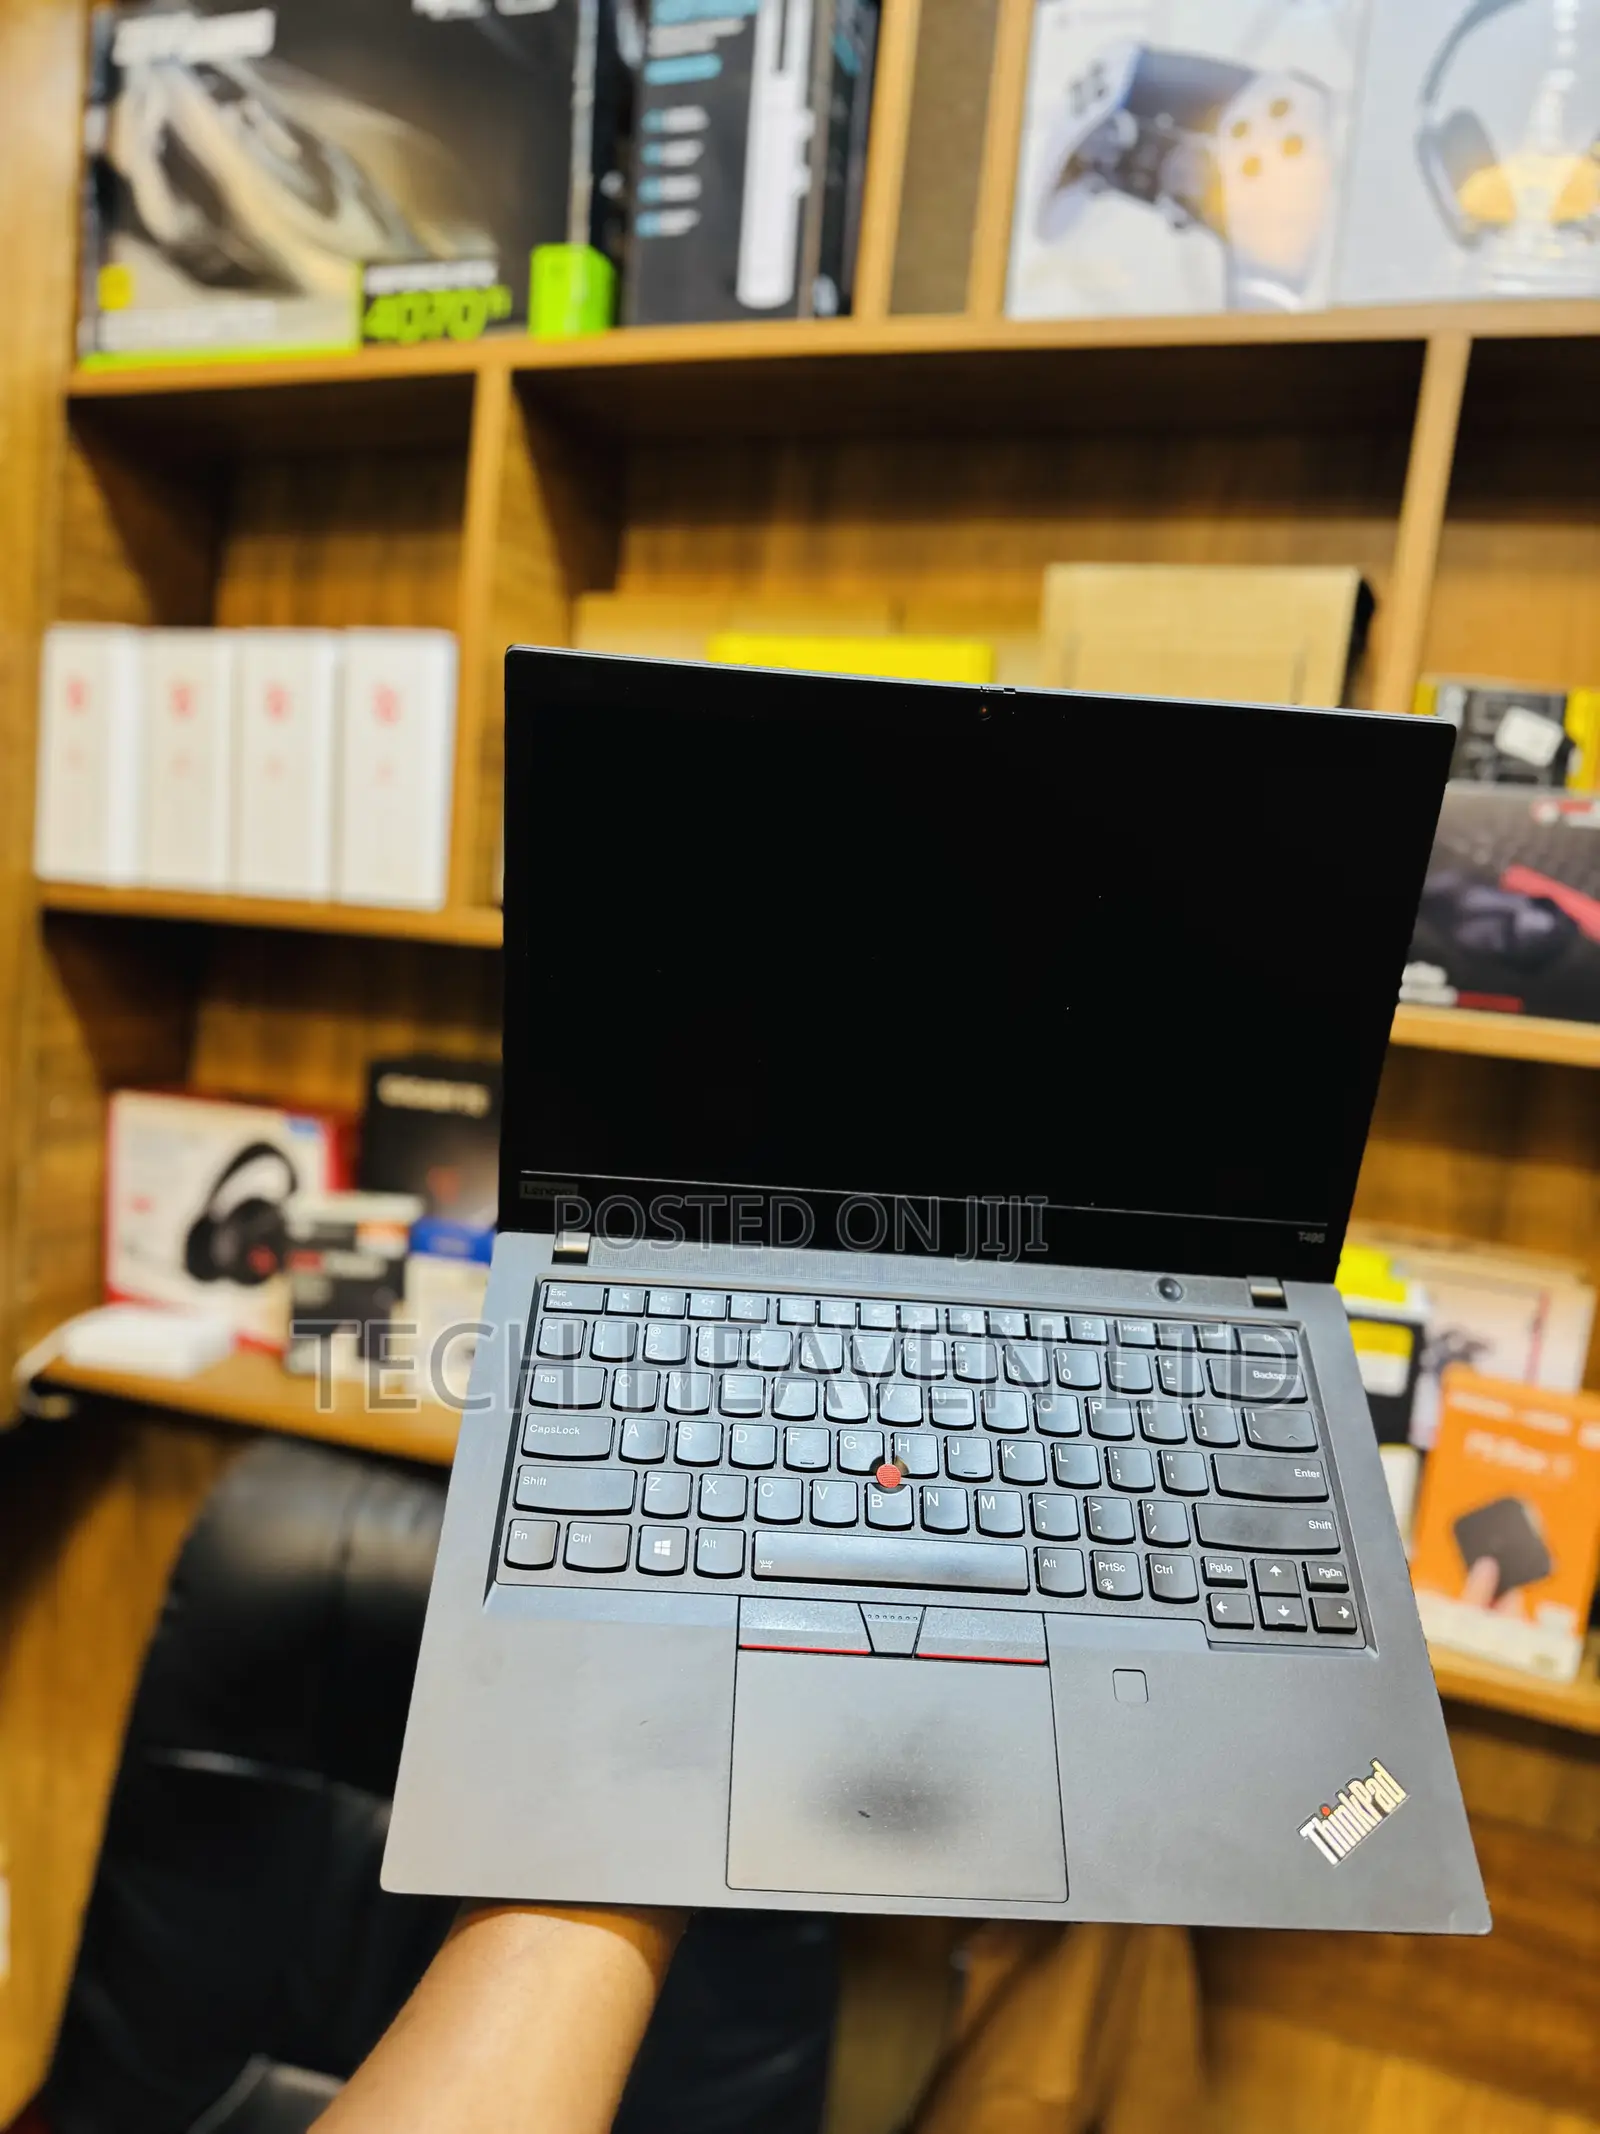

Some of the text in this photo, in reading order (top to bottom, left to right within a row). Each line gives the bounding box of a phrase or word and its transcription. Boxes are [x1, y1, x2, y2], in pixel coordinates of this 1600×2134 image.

[550, 1288, 567, 1297] Esc
[1122, 1324, 1148, 1333] Home
[649, 1343, 659, 1355] 2
[701, 1346, 710, 1358] 3
[753, 1348, 763, 1360] 4
[805, 1351, 815, 1364] 5
[908, 1357, 918, 1370] 7
[1011, 1364, 1021, 1377] 9
[540, 1374, 557, 1383] Tab
[618, 1373, 632, 1388] Q
[673, 1377, 691, 1391] W
[725, 1381, 737, 1394] E
[884, 1388, 895, 1401] Y
[935, 1391, 947, 1406] U
[1091, 1401, 1103, 1415] P
[529, 1423, 581, 1436] CapsLock
[626, 1424, 640, 1438] A
[680, 1426, 693, 1441] S
[735, 1429, 748, 1443] D
[789, 1432, 800, 1446] F
[843, 1435, 857, 1450] G
[897, 1438, 910, 1453] H
[951, 1442, 961, 1456] J
[1003, 1444, 1017, 1460] K
[1057, 1448, 1069, 1463] L
[1293, 1468, 1320, 1479] Enter
[522, 1475, 548, 1487] Shift
[648, 1476, 663, 1492] Z
[704, 1479, 718, 1495] X
[760, 1482, 775, 1498] C
[816, 1485, 829, 1500] V
[871, 1493, 884, 1508] B
[926, 1491, 939, 1507] N
[981, 1495, 996, 1510] M
[1308, 1520, 1333, 1531] Shift
[513, 1530, 529, 1541] Fn
[572, 1532, 593, 1544] Ctrl
[701, 1539, 717, 1549] Alt
[1042, 1558, 1057, 1569] Alt
[1098, 1561, 1126, 1573] PrtSc
[1154, 1564, 1174, 1575] Ctrl
[1209, 1562, 1233, 1573] PgUp
[1318, 1567, 1343, 1578] PgDn
[1296, 1756, 1408, 1867] ThinkPad
